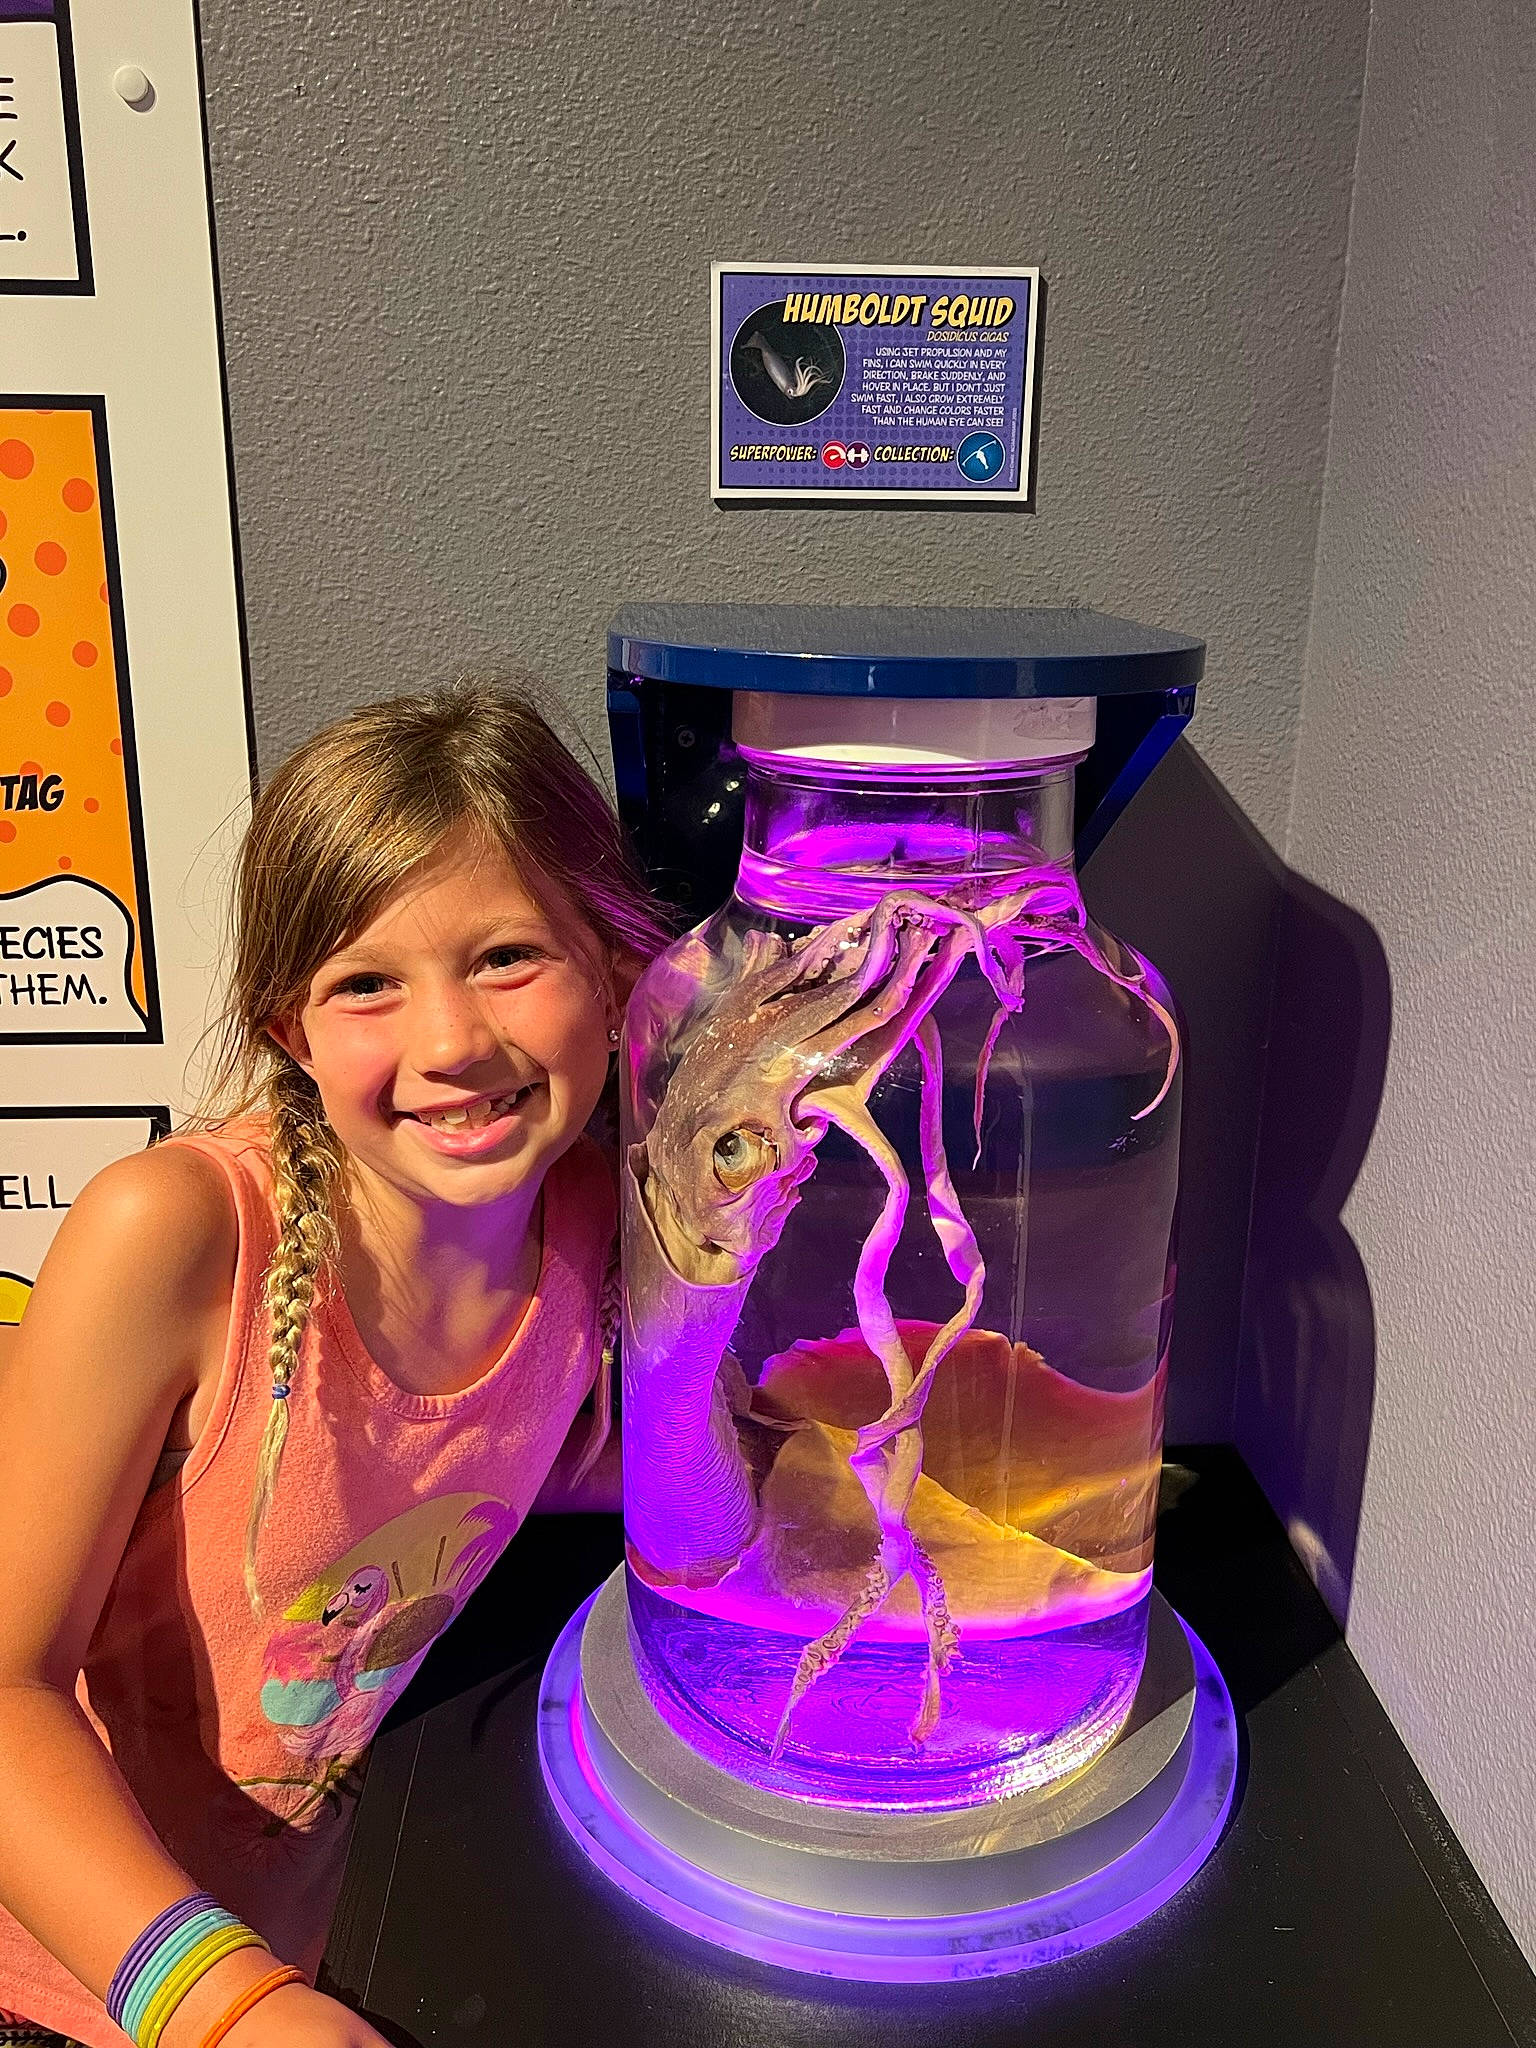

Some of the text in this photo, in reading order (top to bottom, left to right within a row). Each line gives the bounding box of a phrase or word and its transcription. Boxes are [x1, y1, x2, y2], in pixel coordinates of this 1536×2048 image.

[782, 293, 1014, 328] HUMBOLDT SQUID
[927, 331, 1009, 342] DOSIDICUS GIGAS
[875, 347, 1007, 358] USING JET PROPULSION AND MY
[862, 359, 884, 369] FINS,
[889, 359, 907, 368] CAN
[909, 359, 933, 369] SWIM
[934, 360, 968, 369] QUICKLY
[970, 360, 978, 369] IN
[980, 360, 1007, 369] EVERY
[863, 370, 1006, 382] DIRECTION, BRAKE SUDDENLY, AND
[862, 382, 891, 391] HOVER
[892, 382, 900, 391] IN
[933, 383, 950, 392] BUT
[956, 383, 982, 392] DON'T
[983, 383, 1006, 392] JUST
[851, 393, 874, 402] SWIM
[876, 393, 898, 404] FAST,
[904, 394, 927, 403] ALSO
[928, 394, 955, 403] GROW
[956, 394, 1005, 404] EXTREMELY
[861, 405, 1004, 415] FAST AND CHANGE COLORS FASTER
[872, 416, 1004, 427] THAN THE HUMAN EYE CAN SEE!
[729, 445, 954, 462] SUPERPOWER: COLLECTION:
[0, 774, 64, 812] TAG
[0, 926, 104, 959] ECIES
